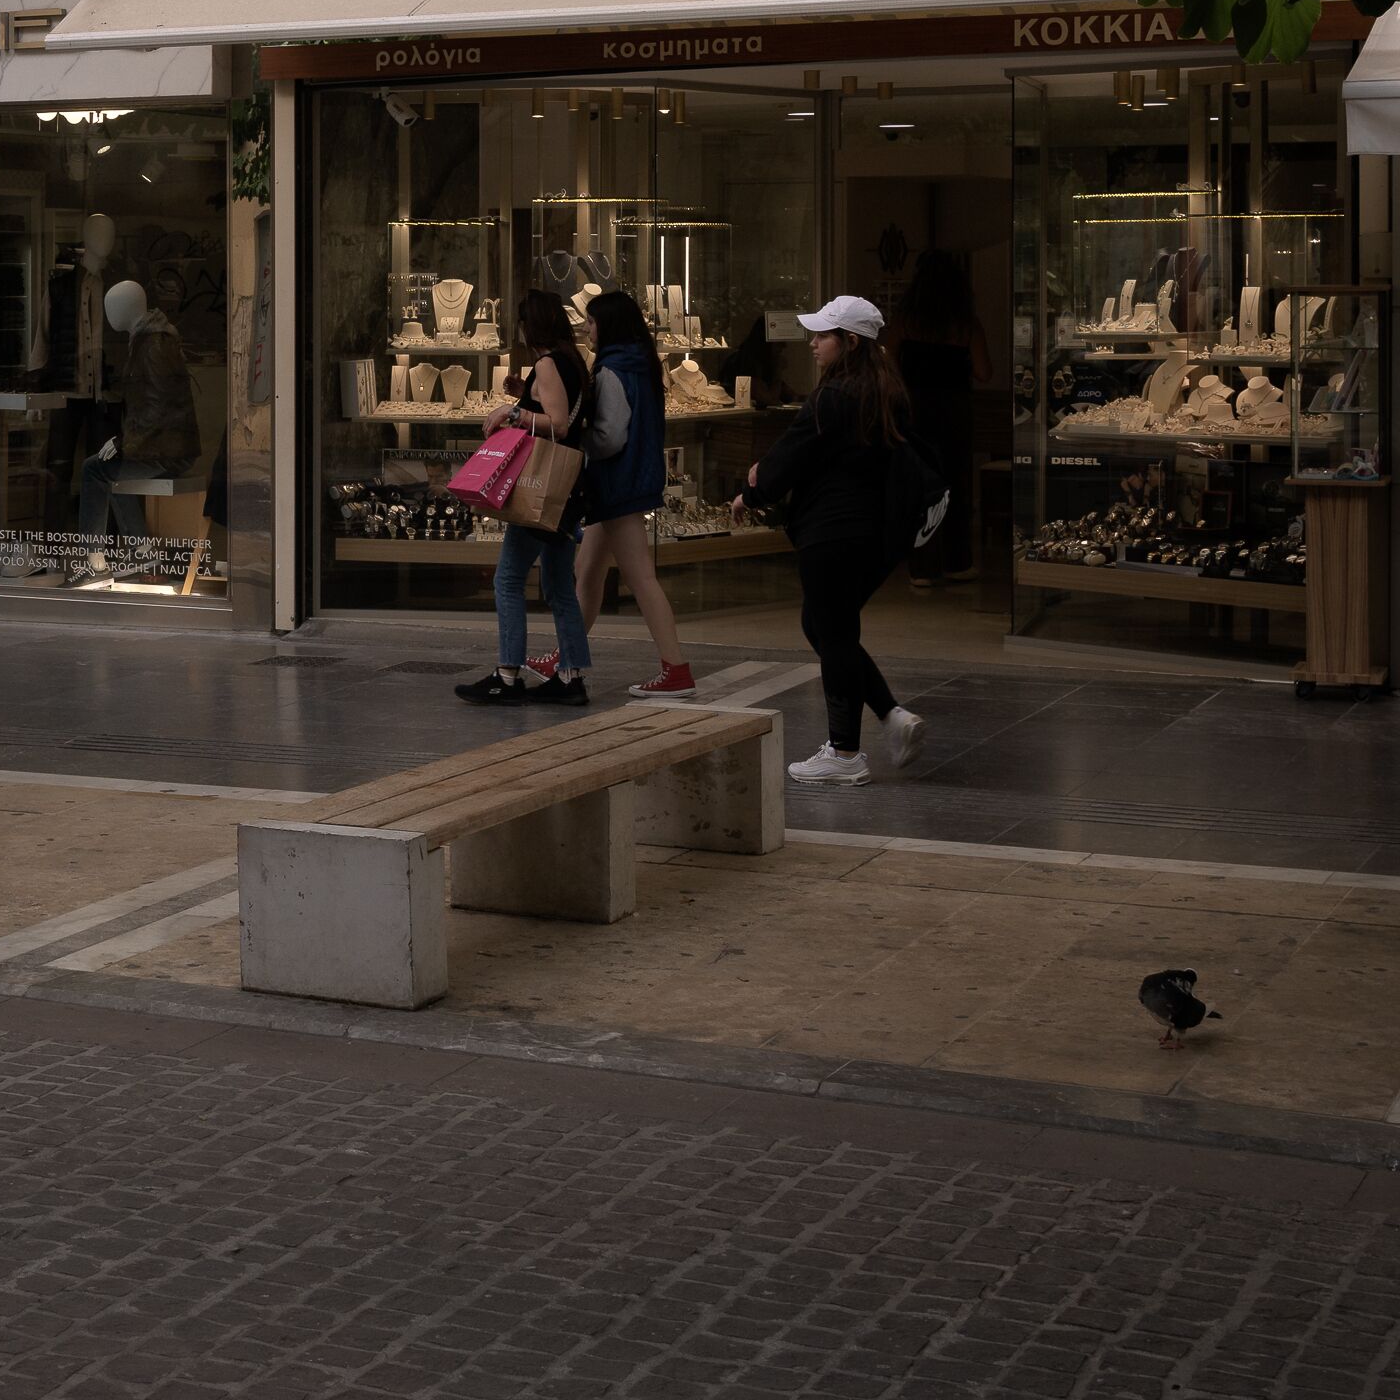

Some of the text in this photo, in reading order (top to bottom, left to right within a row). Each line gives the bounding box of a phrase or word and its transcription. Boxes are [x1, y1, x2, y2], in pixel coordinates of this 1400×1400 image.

[603, 33, 763, 61] κοσμηματα
[375, 43, 481, 72] ρολόγια
[1051, 456, 1102, 466] DIESEL
[24, 531, 45, 541] THE
[47, 532, 114, 545] BOSTONIANS
[123, 535, 162, 547] TOMMY
[165, 538, 212, 550] HILFIGER
[32, 544, 89, 557] TRUSSARDI
[134, 550, 170, 561] CAMEL
[28, 558, 60, 569] ASSN.
[70, 560, 93, 570] GUY
[160, 564, 212, 577] NAUTCA
